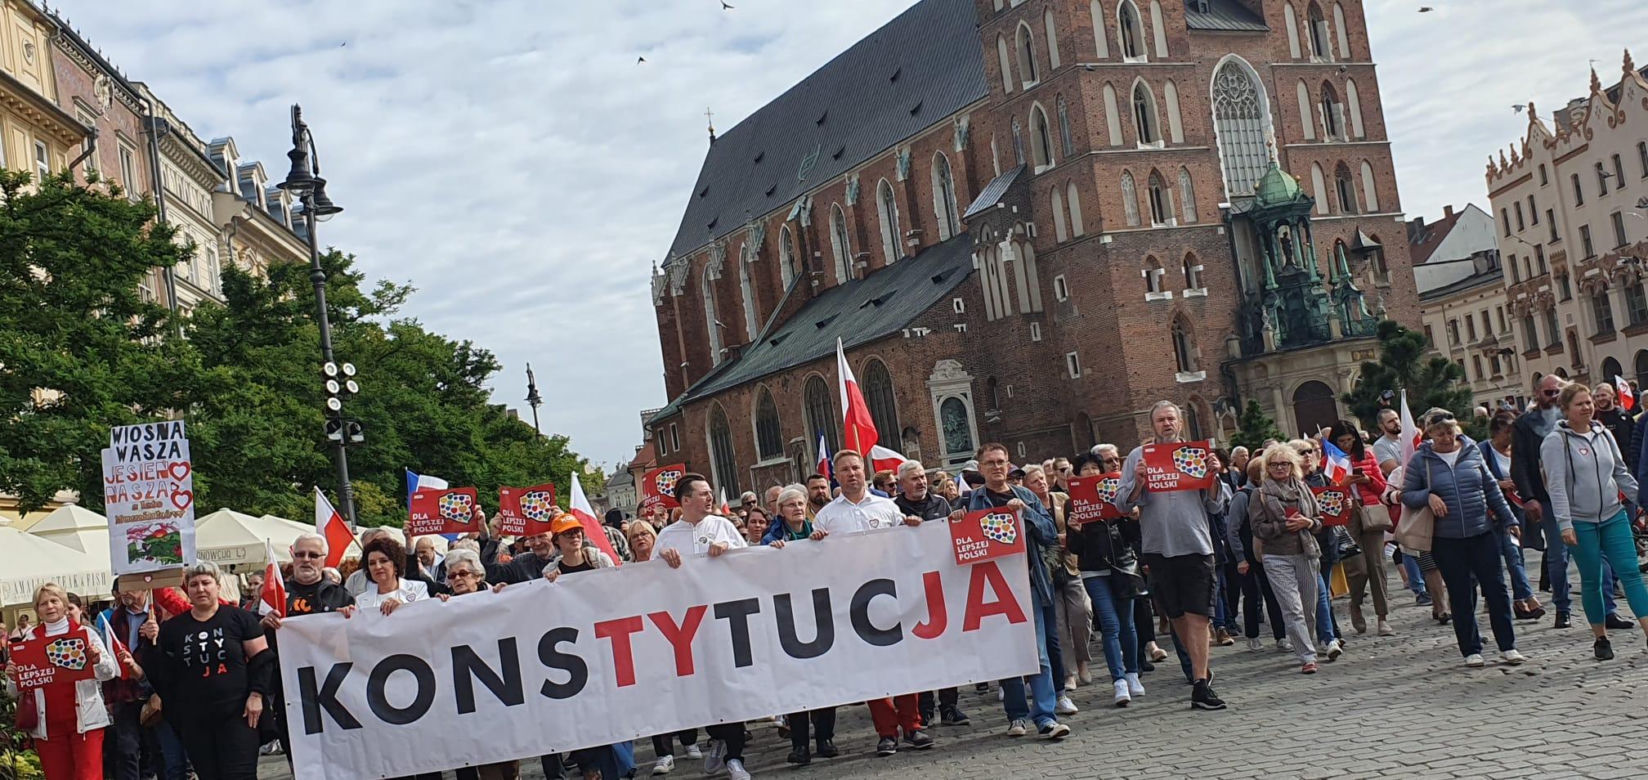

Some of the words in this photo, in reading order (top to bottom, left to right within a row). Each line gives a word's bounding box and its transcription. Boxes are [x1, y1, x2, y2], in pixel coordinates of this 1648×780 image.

[112, 422, 183, 445] WIOSNA
[116, 441, 182, 463] WASZA
[1148, 473, 1180, 482] LEPSZEJ
[1149, 481, 1178, 489] POLSKI
[105, 481, 169, 505] NASZA
[1074, 503, 1103, 513] LEPSZEJ
[413, 519, 444, 527] LEPSZEJ
[414, 525, 442, 533] POLSKI
[503, 525, 524, 534] POLSKI
[956, 536, 972, 545] DLA
[957, 540, 989, 553] LEPSZEJ
[959, 549, 987, 560] POLSKI
[297, 561, 1028, 735] KONSTYTUCJA
[17, 664, 37, 672] DLA
[19, 667, 55, 680] LEPSZEJ
[20, 676, 53, 688] POLSKI
